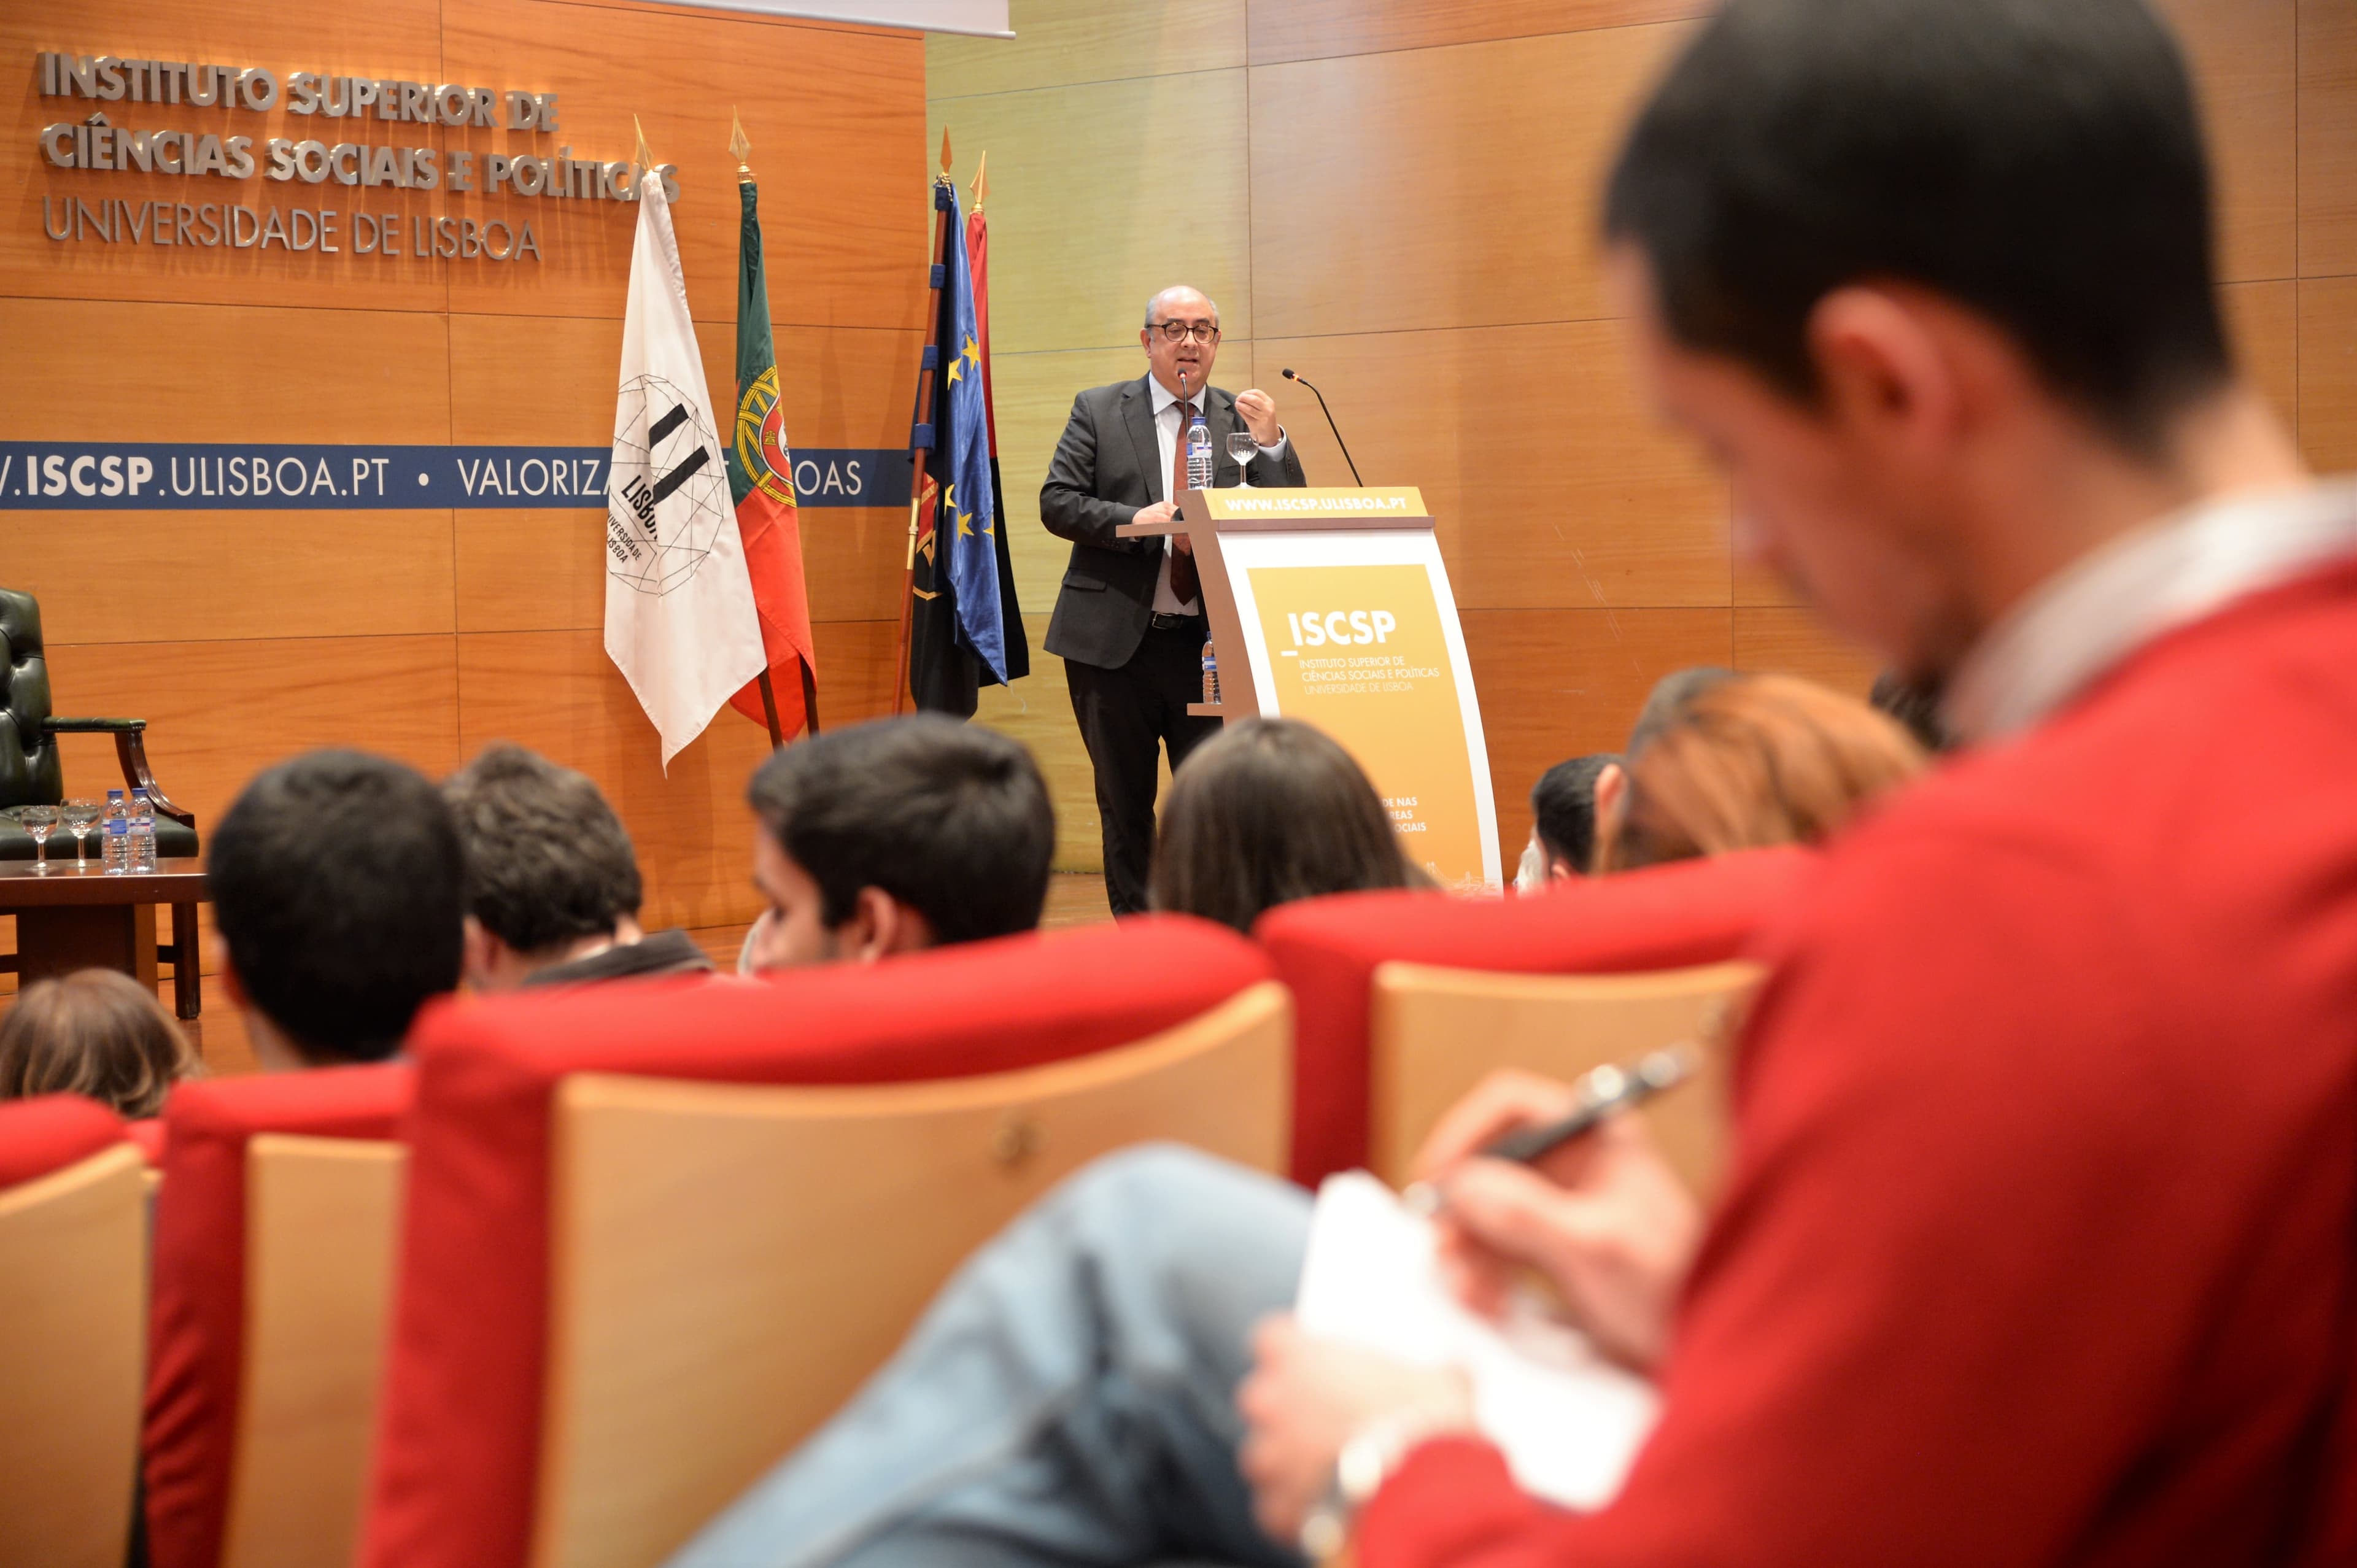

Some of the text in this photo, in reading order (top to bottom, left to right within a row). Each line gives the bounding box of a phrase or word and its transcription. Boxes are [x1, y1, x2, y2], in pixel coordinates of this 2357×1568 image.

[38, 52, 559, 133] INSTITUTO SUPERIOR DE
[41, 111, 254, 179] CIÊNCIAS
[265, 137, 439, 190] SOCIAIS
[448, 151, 473, 191] E
[43, 196, 541, 261] UNIVERSIDADE DE LISBOA
[457, 458, 610, 496] VALORIZ
[1225, 497, 1407, 511] WWW.ISCSP.ULISBOA.PT
[1287, 610, 1396, 646] ISCSP
[1299, 655, 1405, 669] INSTITUTO SUPERIOR DE
[1301, 666, 1440, 682] CIÊNCIAS SOCIAIS E POLÍTICAS
[1304, 681, 1414, 695] UNIVERSIDADE DE LISBOA
[1396, 797, 1417, 806] NAS
[1389, 810, 1413, 820] REAS
[1394, 822, 1426, 832] OCIAIS
